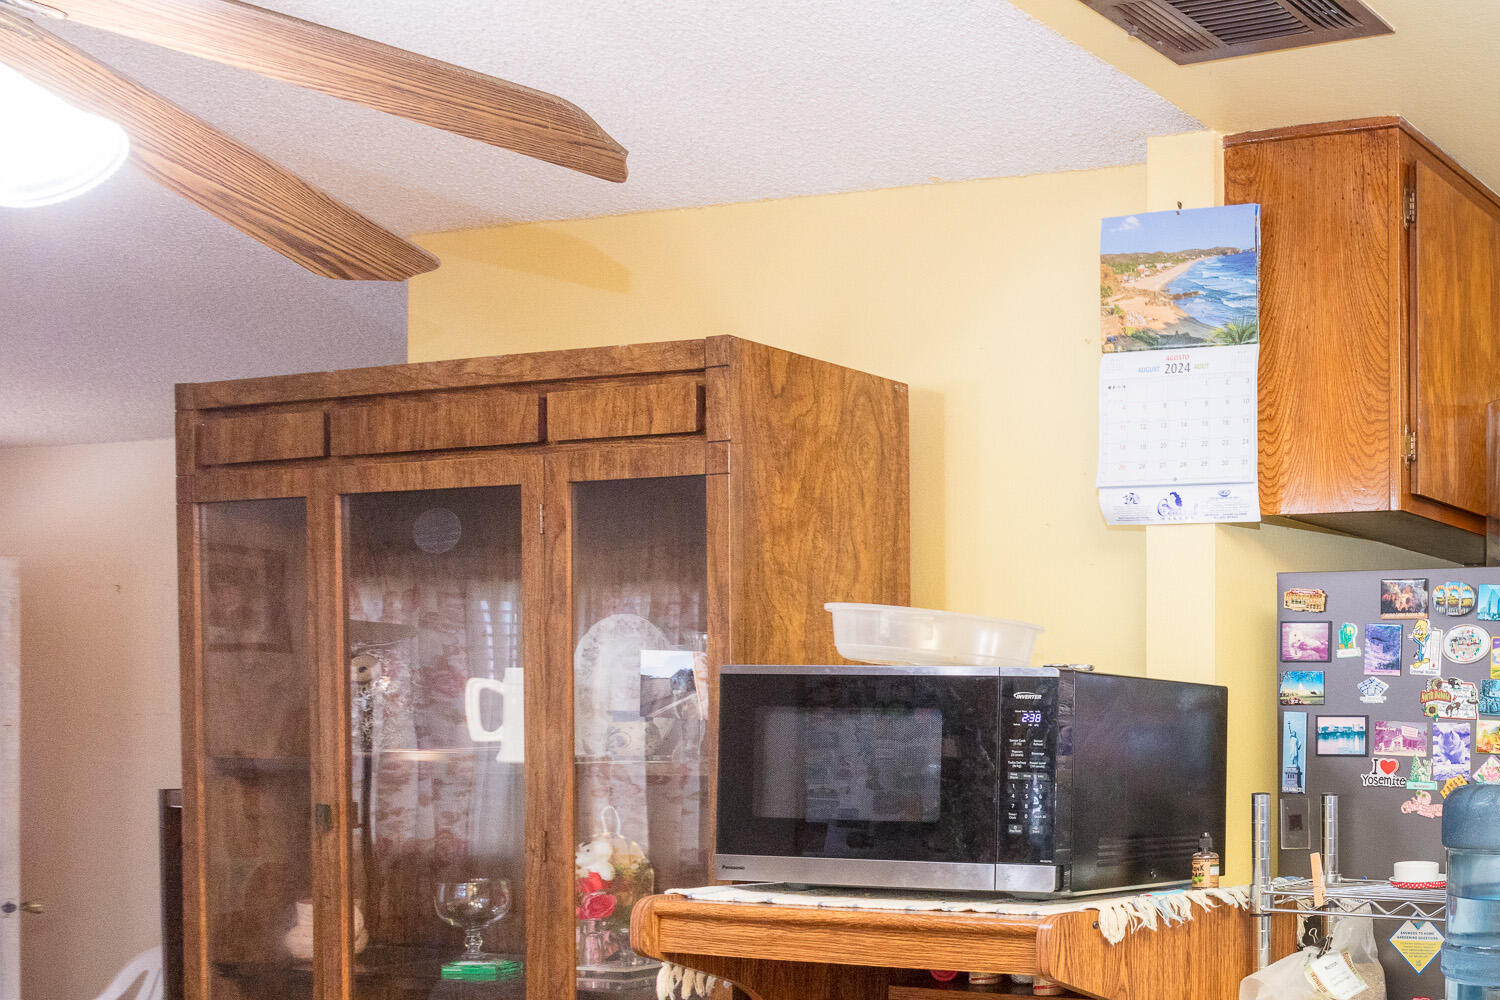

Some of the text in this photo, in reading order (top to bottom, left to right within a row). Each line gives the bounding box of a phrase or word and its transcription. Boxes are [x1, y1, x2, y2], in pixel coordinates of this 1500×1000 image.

[1164, 363, 1190, 374] 2024
[1021, 713, 1042, 723] 2:38
[1371, 758, 1378, 775] I
[1361, 774, 1406, 787] Yosemite
